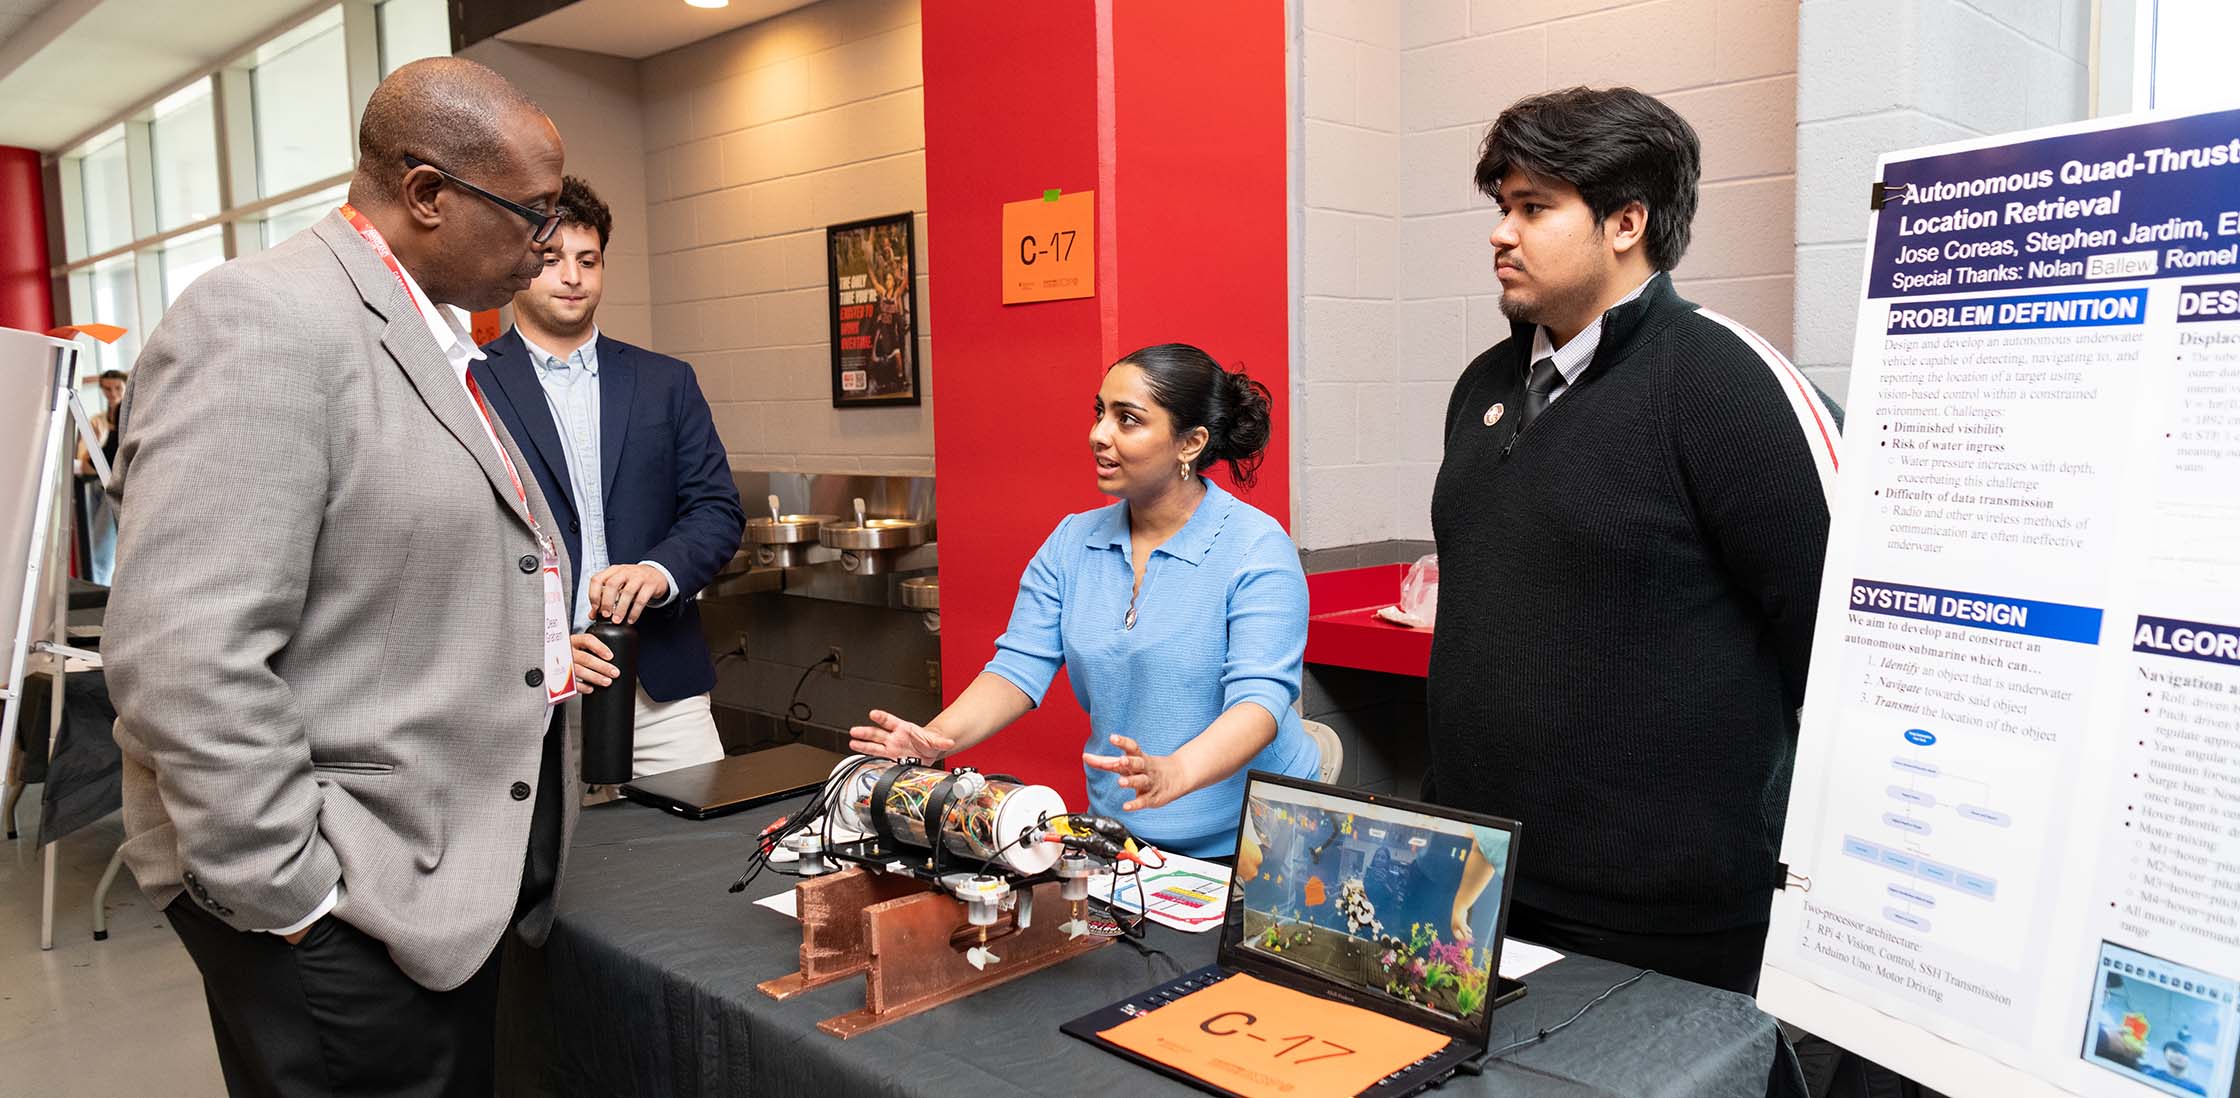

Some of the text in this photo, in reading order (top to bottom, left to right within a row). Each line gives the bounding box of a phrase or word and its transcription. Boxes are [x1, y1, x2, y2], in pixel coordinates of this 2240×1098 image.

[1902, 169, 2054, 204] Autonomous
[1899, 190, 2121, 236] Location Retrieval
[1020, 230, 1077, 266] C-17
[1895, 246, 1939, 264] Jose
[1944, 240, 2019, 260] Coreas,
[2026, 228, 2116, 253] Stephen
[2122, 217, 2209, 244] Jardim,
[1892, 269, 1952, 291] Special
[1956, 265, 2024, 284] Thanks:
[2028, 260, 2083, 279] Nolan
[2165, 244, 2238, 269] Romel
[1888, 297, 2138, 329] PROBLEM DEFINITION
[2179, 290, 2240, 316] DES
[1882, 354, 1918, 367] vehicle
[1919, 353, 1959, 368] capable
[1961, 352, 1975, 365] of
[2031, 352, 2093, 366] navigating
[2115, 349, 2140, 361] and
[1884, 338, 1919, 353] Design
[1920, 336, 1941, 349] and
[1942, 336, 1984, 351] develop
[2002, 335, 2071, 346] autonomous
[2075, 332, 2143, 344] underwater
[1878, 388, 1940, 400] vision-based
[1942, 387, 1980, 400] control
[1983, 387, 2017, 400] within
[2029, 388, 2098, 400] constrained
[1879, 371, 1925, 386] reporting
[1927, 371, 1944, 383] the
[1946, 370, 1988, 383] location
[1990, 370, 2003, 383] of
[2015, 371, 2047, 384] target
[2049, 369, 2082, 384] using
[1894, 421, 2004, 437] Diminished visibility
[1891, 438, 2005, 454] Risk of water ingress
[1900, 454, 1929, 467] Water
[1930, 458, 1975, 470] pressure
[1977, 458, 2027, 471] increases
[2030, 460, 2056, 473] with
[1885, 487, 2053, 509] Difficulty of data transmission
[1896, 473, 2039, 493] exacerbating this challenge
[1892, 504, 2089, 530] Radio and other wireless methods of
[1887, 538, 1943, 553] underwater
[1889, 524, 2083, 548] communication are often ineffective
[1852, 586, 2028, 628] SYSTEM DESIGN
[1848, 613, 1864, 626] We
[1865, 617, 1885, 629] aim
[1900, 621, 1942, 640] develop
[1944, 630, 1966, 641] and
[1968, 634, 2023, 650] construct
[2025, 643, 2041, 653] an
[1844, 634, 1906, 651] autonomous
[1908, 644, 1967, 661] submarine
[1970, 653, 2004, 668] which
[1879, 676, 1922, 694] Navigate
[1924, 686, 1965, 703] towards
[1967, 695, 1991, 708] said
[1992, 698, 2027, 715] object
[1880, 657, 1920, 676] Identify
[1921, 666, 1935, 677] an
[1936, 668, 1969, 683] object
[1971, 673, 1992, 688] that
[2007, 682, 2072, 701] underwater
[1874, 695, 1920, 713] Transmit
[1921, 704, 1938, 719] the
[1940, 708, 1983, 727] location
[1985, 718, 1999, 731] of
[2000, 720, 2018, 734] the
[2020, 726, 2056, 742] object
[1814, 941, 1850, 963] Arduino
[1875, 964, 1904, 984] Motor
[1906, 976, 1943, 1003] Driving
[1817, 923, 1833, 938] RPi
[1918, 962, 1942, 979] SSH
[1944, 971, 2011, 1006] Transmission
[1200, 1011, 1356, 1067] C-17
